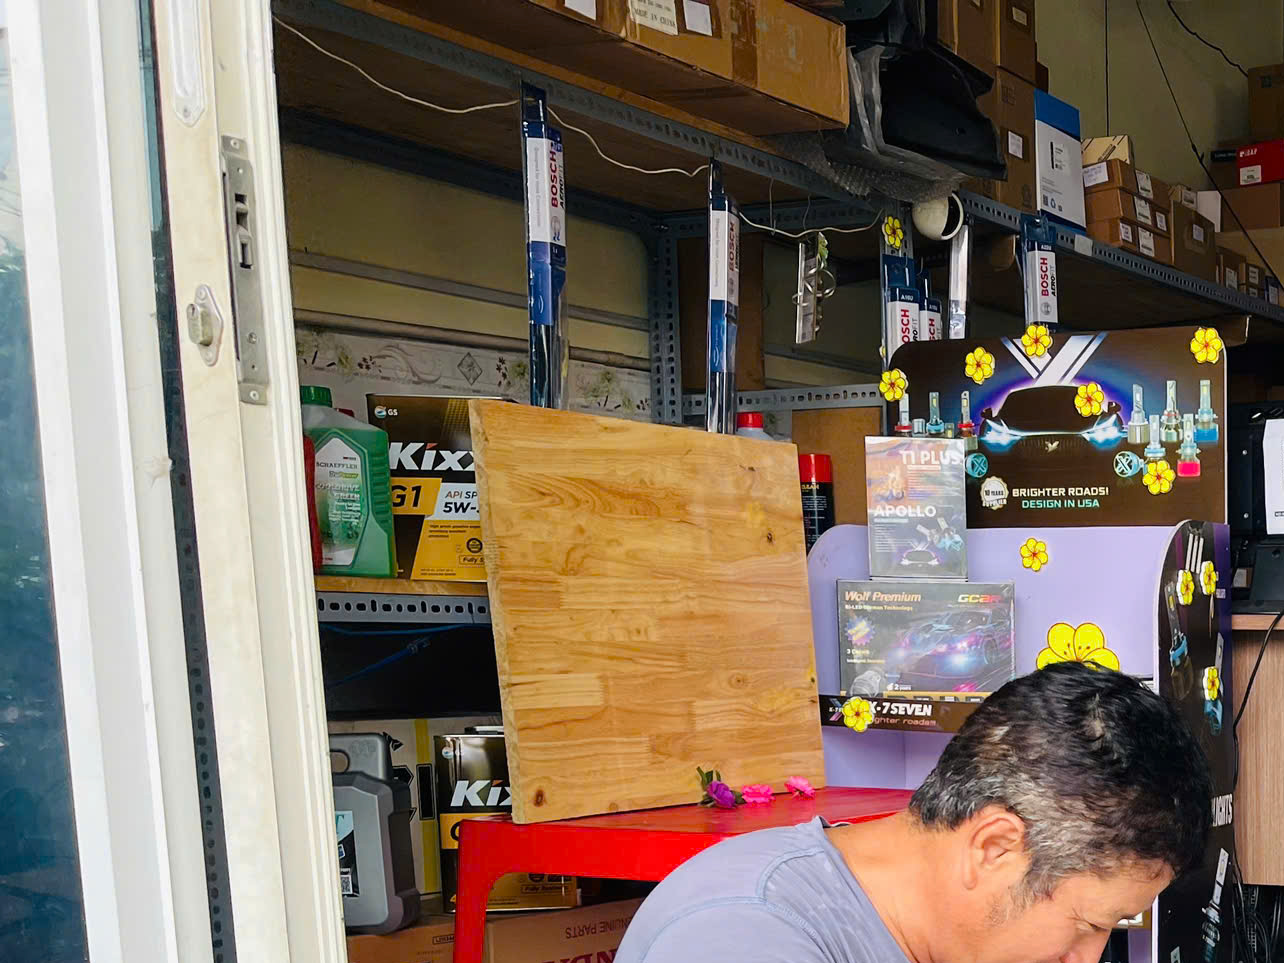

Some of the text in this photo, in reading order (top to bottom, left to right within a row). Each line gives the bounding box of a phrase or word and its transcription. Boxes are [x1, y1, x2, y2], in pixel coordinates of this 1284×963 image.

[549, 150, 559, 208] BOSCH
[1040, 257, 1049, 297] BOSCH
[387, 408, 398, 416] GS
[920, 450, 960, 465] PLUS
[391, 485, 422, 508] G1
[445, 491, 463, 499] API
[1012, 486, 1109, 497] BRIGHTER ROADS!
[443, 502, 480, 513] 5W-
[1022, 499, 1100, 508] DESIGN IN USA
[874, 505, 937, 517] APOLLO
[845, 591, 921, 602] Wolf Premium
[565, 924, 597, 939] PARTS
